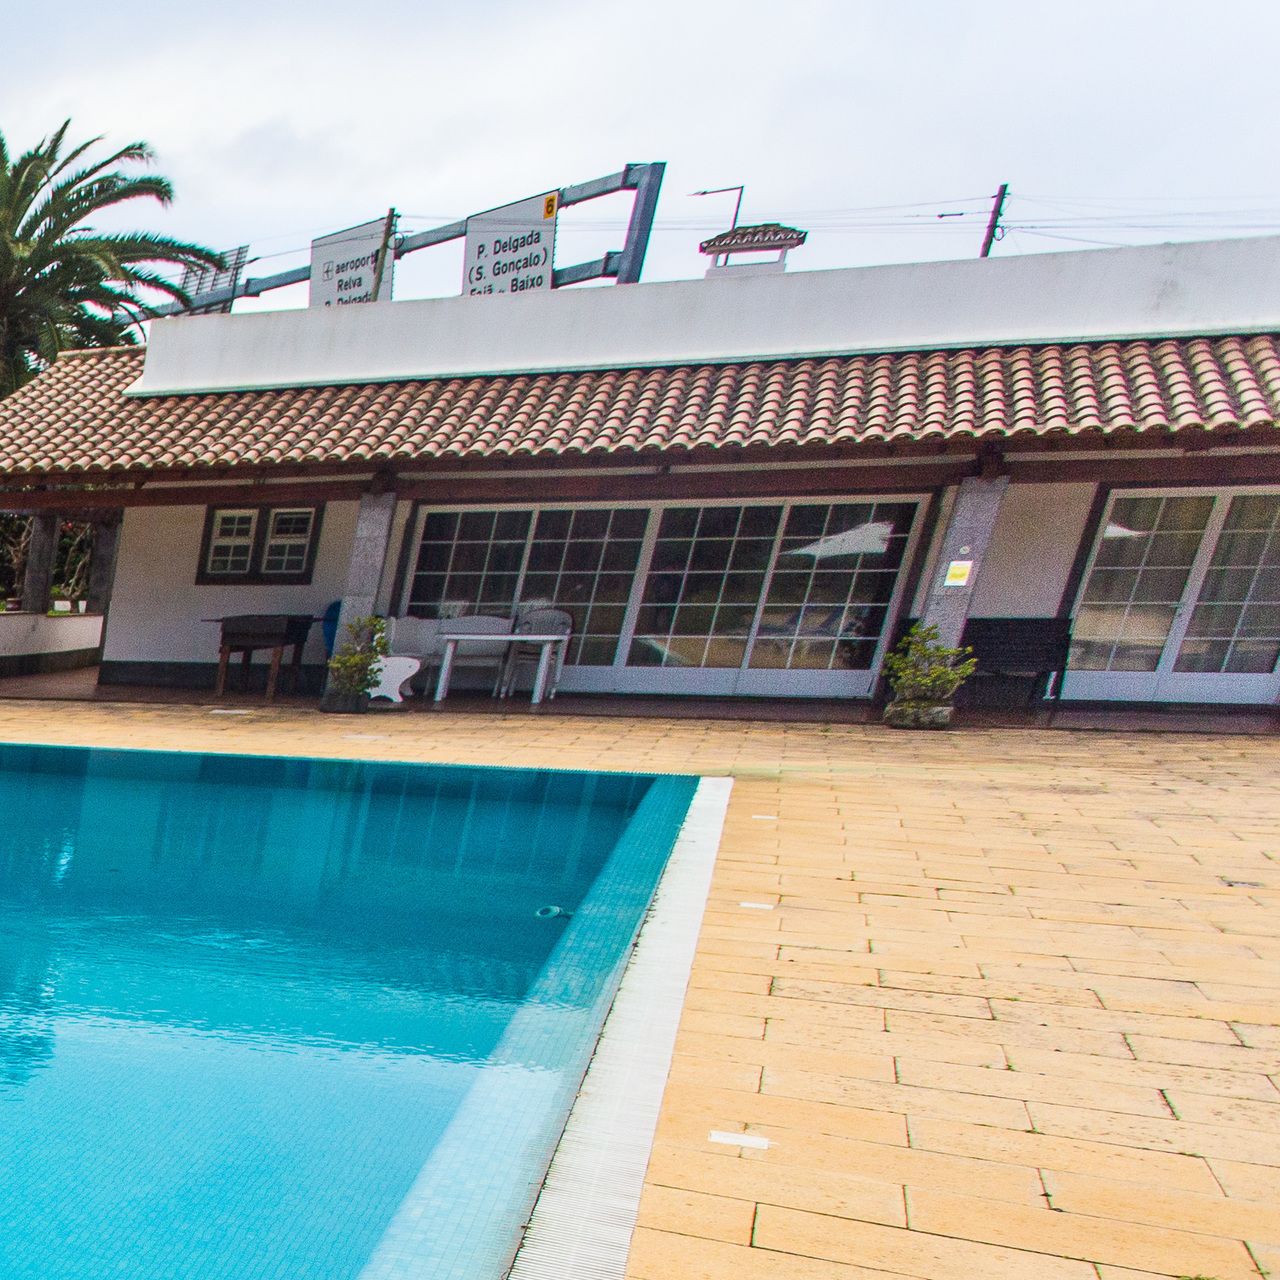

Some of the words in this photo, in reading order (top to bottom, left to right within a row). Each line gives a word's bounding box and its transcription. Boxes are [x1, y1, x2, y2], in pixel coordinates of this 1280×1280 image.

[546, 198, 555, 215] 6
[477, 243, 488, 260] P.
[493, 230, 541, 256] Delgada
[335, 252, 379, 275] aeroport
[468, 266, 486, 285] (S.
[492, 246, 547, 277] Gonçalo)
[337, 276, 362, 292] Relva
[510, 274, 543, 293] Baixo
